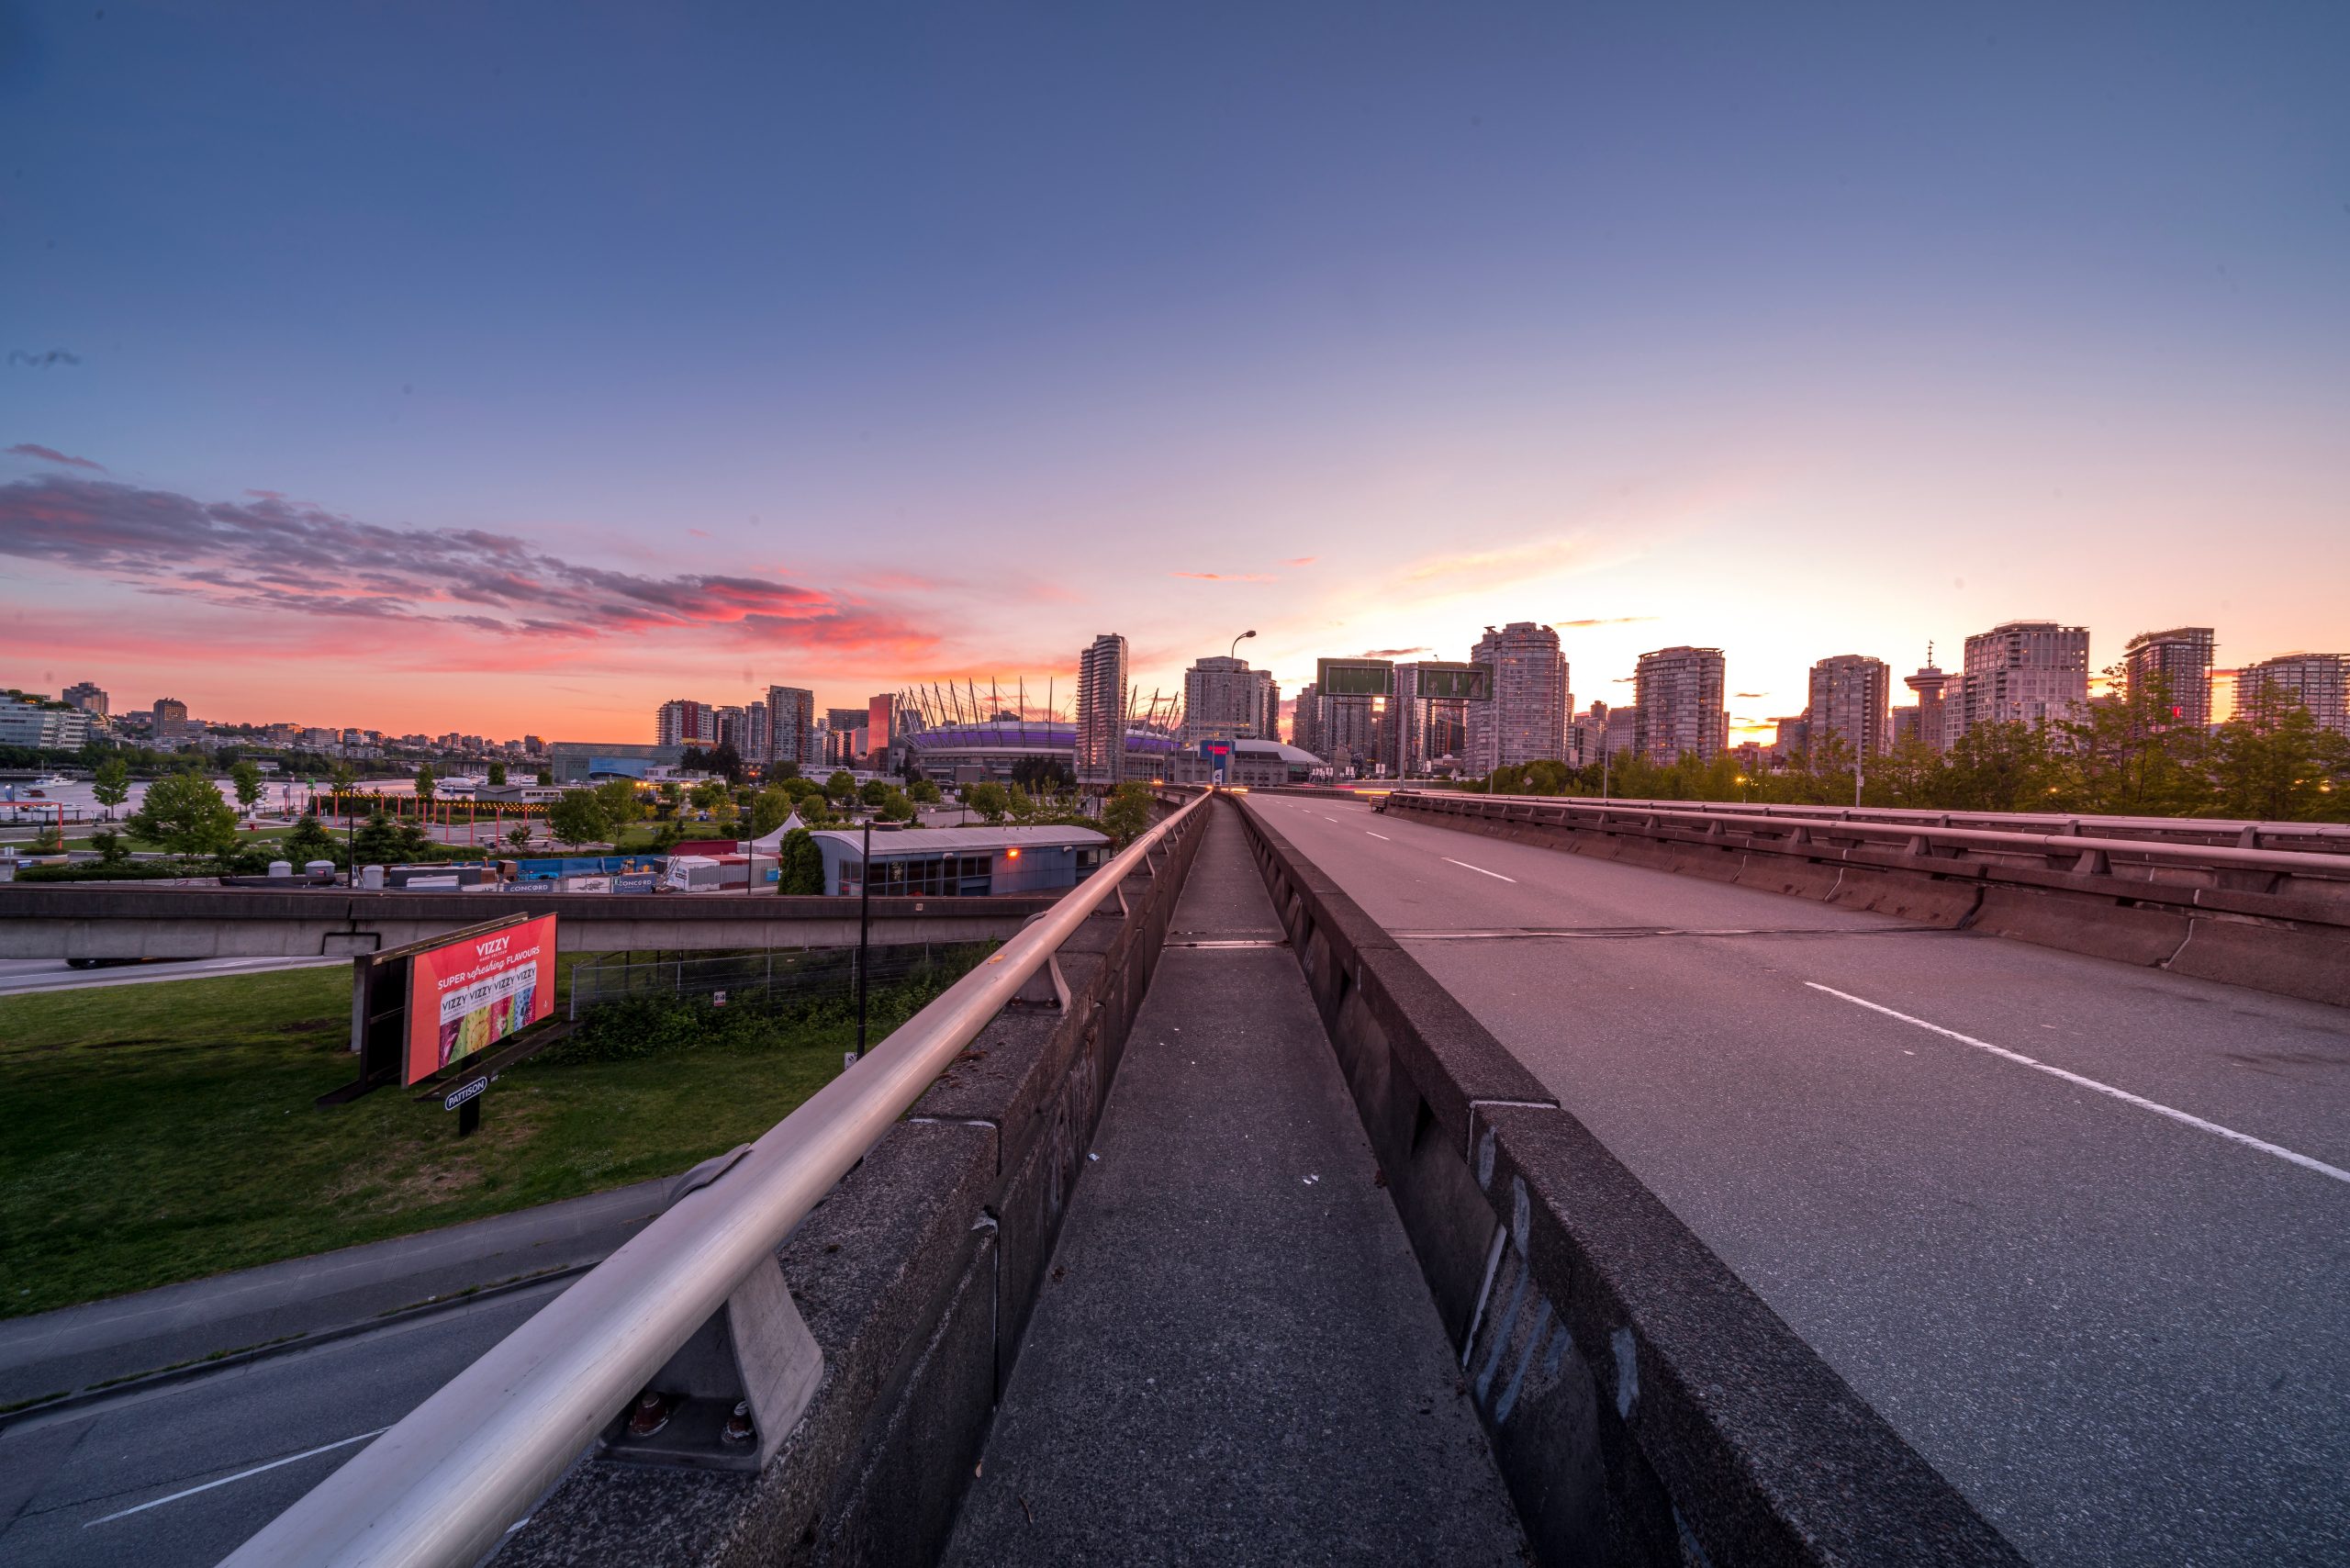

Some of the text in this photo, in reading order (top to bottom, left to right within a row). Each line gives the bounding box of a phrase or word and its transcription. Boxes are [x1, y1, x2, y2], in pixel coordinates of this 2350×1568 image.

[476, 935, 509, 957] VIZZY
[437, 946, 540, 991] SUPER refreshing FLAVOURS
[516, 968, 536, 981] VIZZY
[494, 976, 515, 991] VIZZY
[469, 985, 492, 1001] VIZZY
[442, 994, 467, 1012] VIZZY
[448, 1080, 485, 1107] PATTISON
